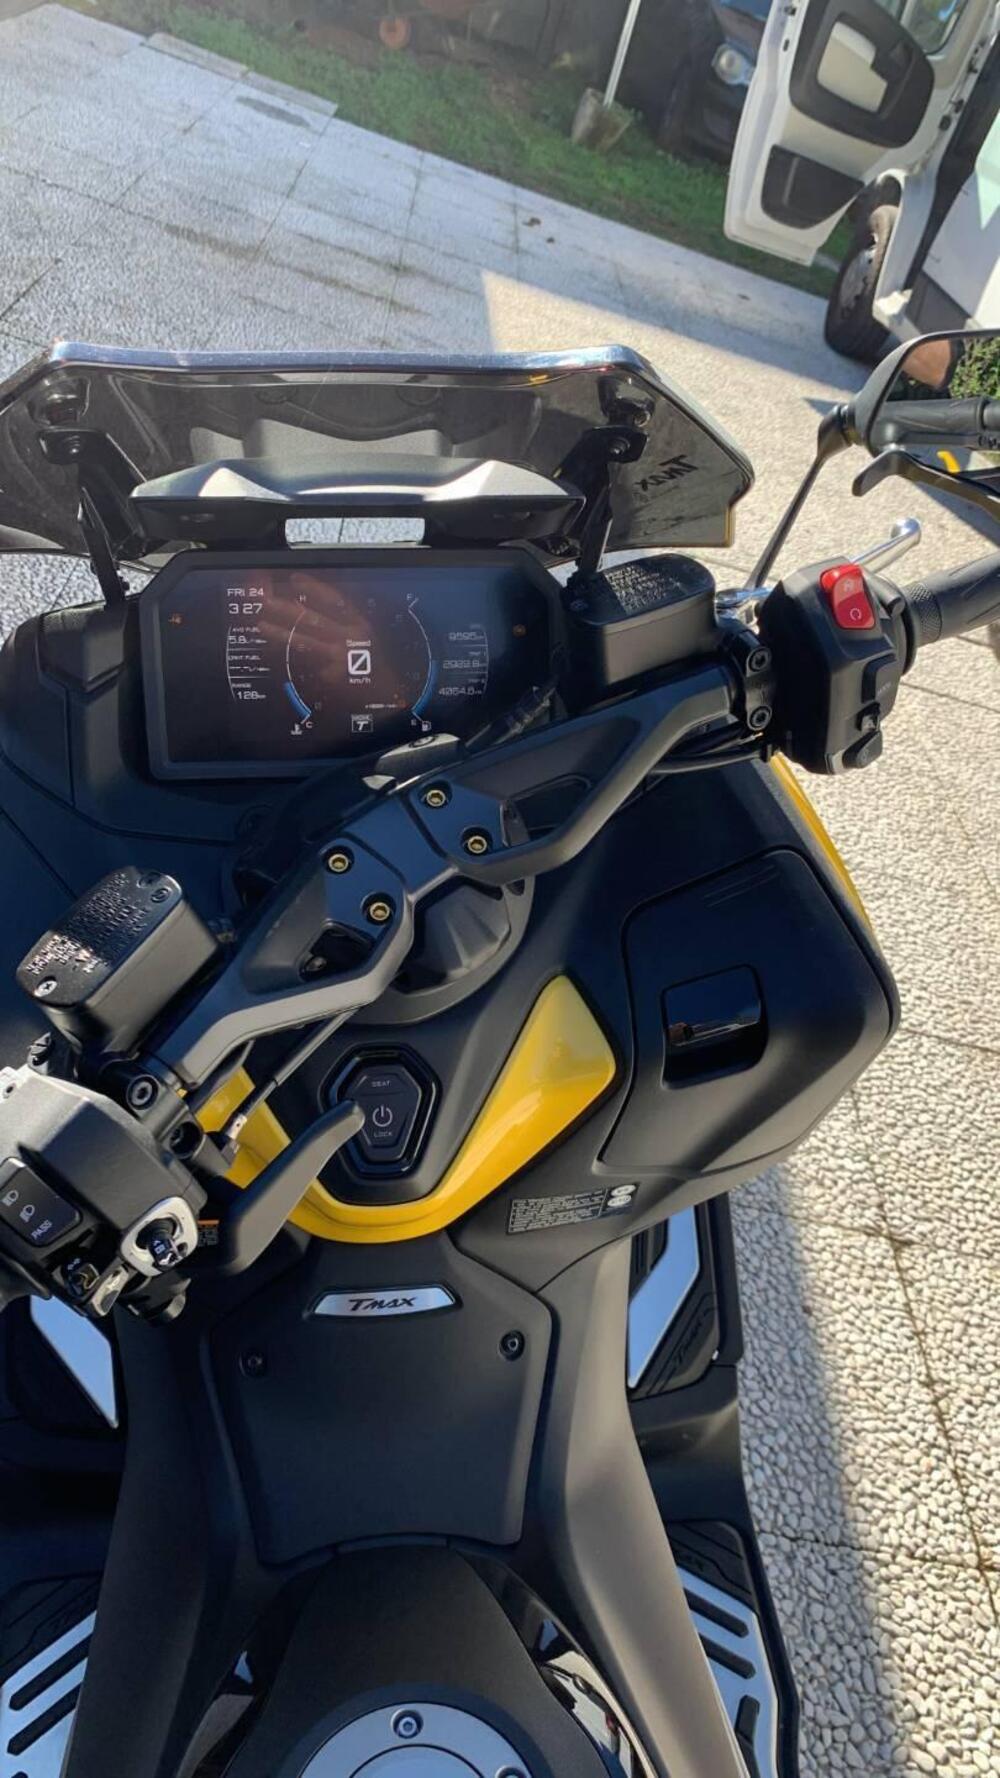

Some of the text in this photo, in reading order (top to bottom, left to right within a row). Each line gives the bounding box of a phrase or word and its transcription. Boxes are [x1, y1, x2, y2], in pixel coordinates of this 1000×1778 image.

[227, 588, 264, 597] FRI 24
[31, 1219, 52, 1240] PASS
